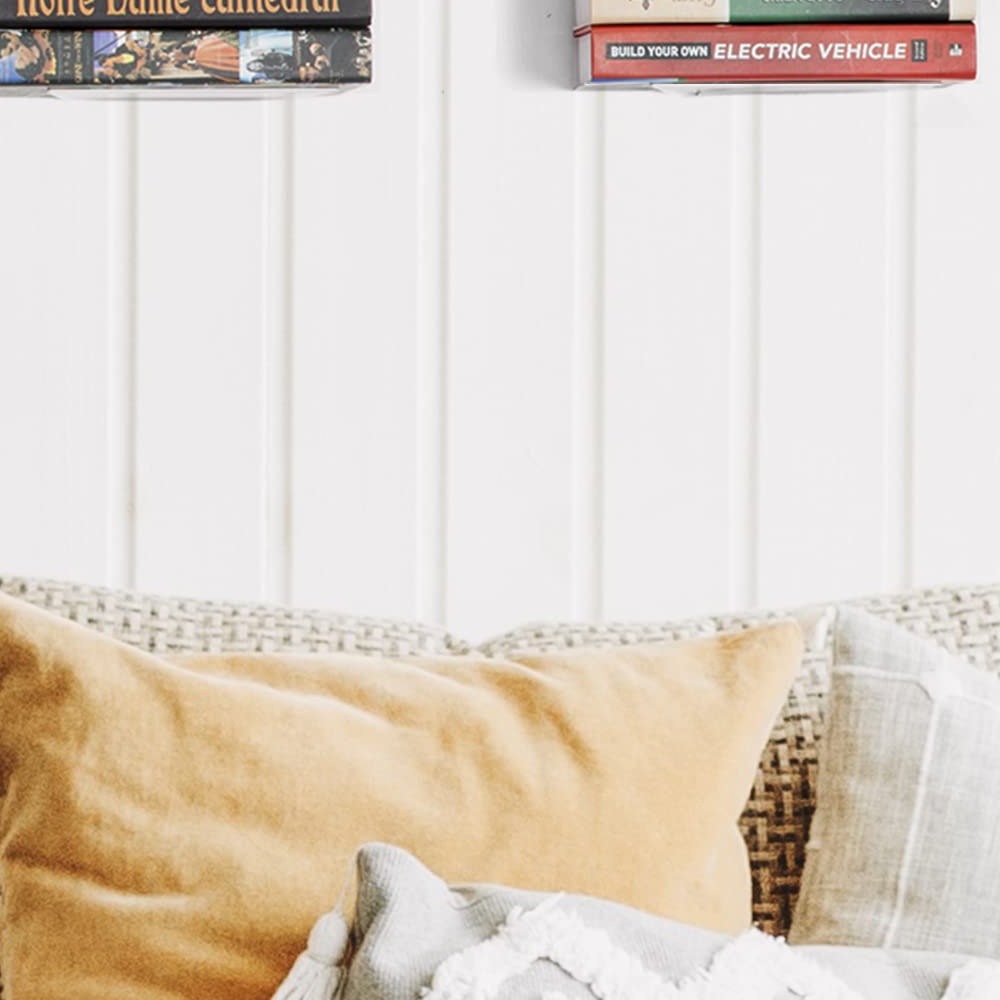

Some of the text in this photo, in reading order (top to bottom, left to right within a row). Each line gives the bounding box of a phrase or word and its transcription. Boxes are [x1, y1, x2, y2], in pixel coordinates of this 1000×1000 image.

[610, 45, 709, 58] BUILD YOUR OWN
[713, 42, 812, 60] ELECTRIC
[818, 42, 907, 60] VEHICLE
